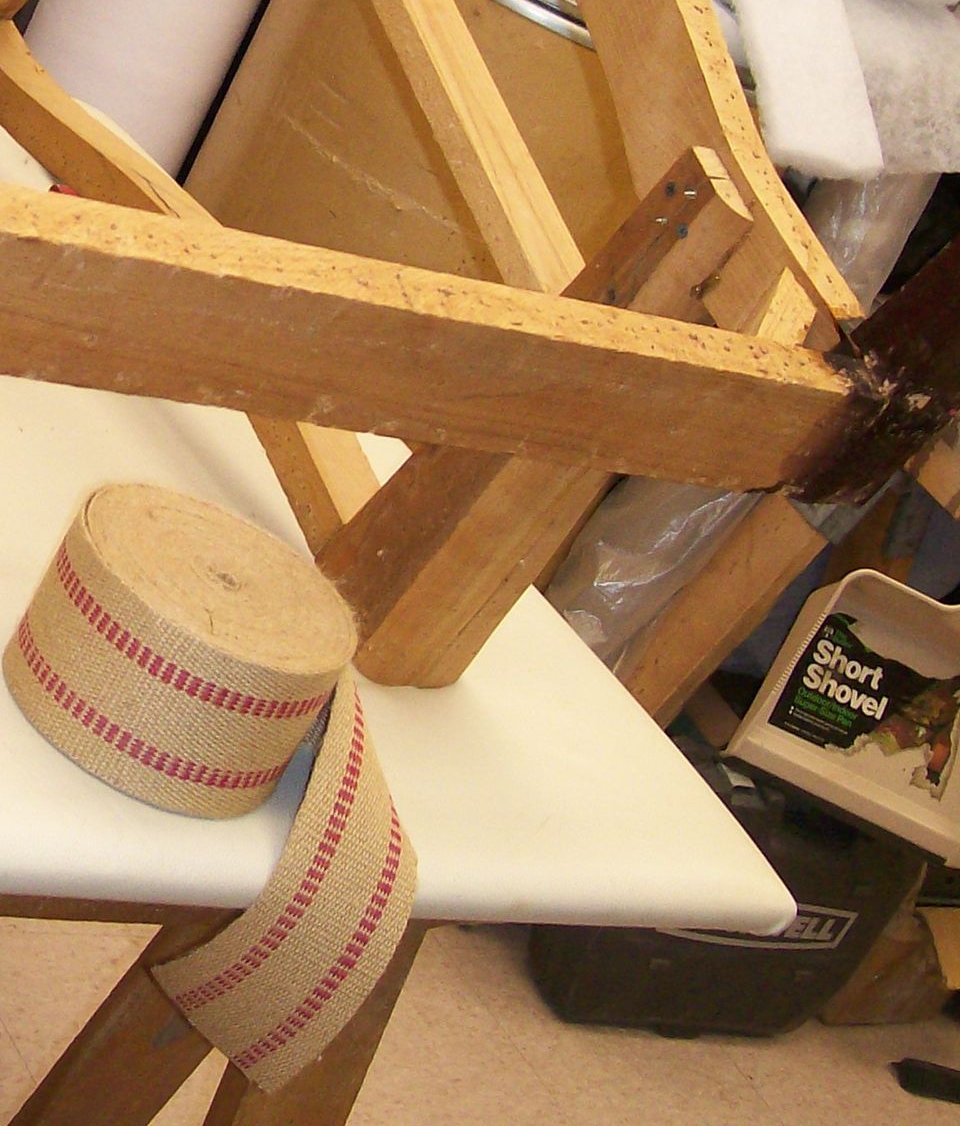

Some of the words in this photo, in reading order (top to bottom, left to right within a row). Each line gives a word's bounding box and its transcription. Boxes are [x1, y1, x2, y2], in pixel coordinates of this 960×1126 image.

[813, 639, 883, 690] Short
[803, 663, 888, 720] Shovel
[784, 916, 835, 940] ELL
